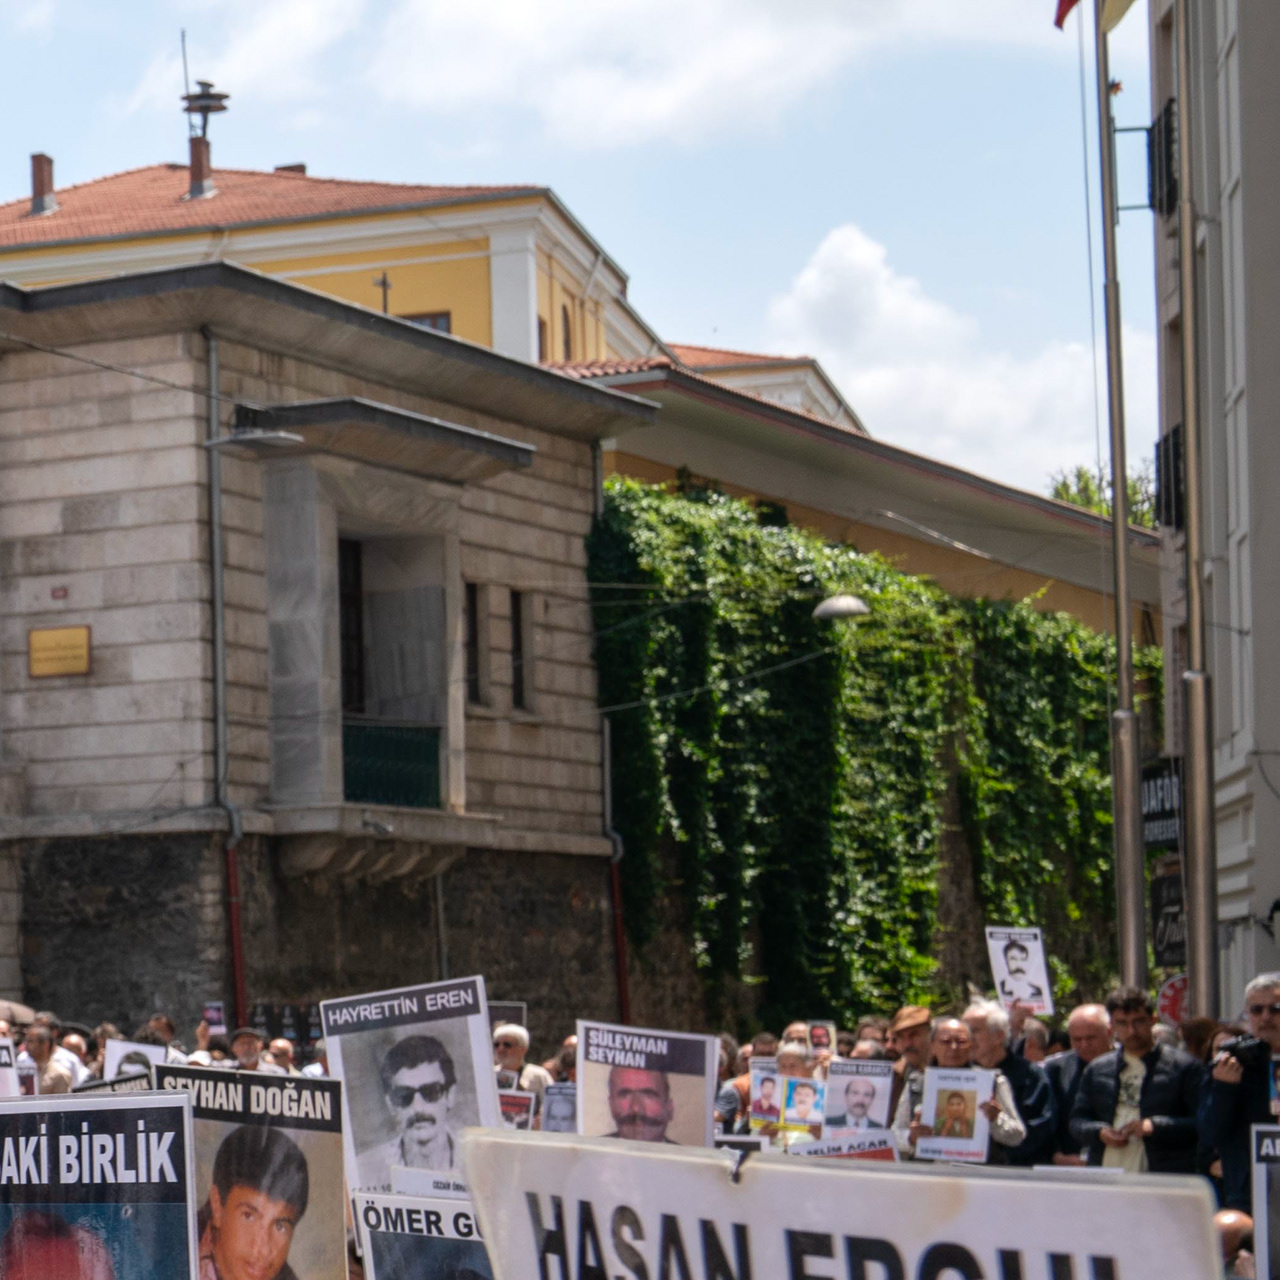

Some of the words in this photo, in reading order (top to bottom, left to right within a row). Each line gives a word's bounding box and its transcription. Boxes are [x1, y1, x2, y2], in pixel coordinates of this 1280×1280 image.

[327, 994, 420, 1027] HAYRETTİN
[424, 987, 475, 1011] EREN
[588, 1029, 669, 1055] SÜLEYMAN
[588, 1047, 646, 1069] SEYHAN
[249, 1070, 332, 1121] DOĞAN
[59, 1121, 179, 1185] BİRLİK
[363, 1200, 445, 1237] ÖMER
